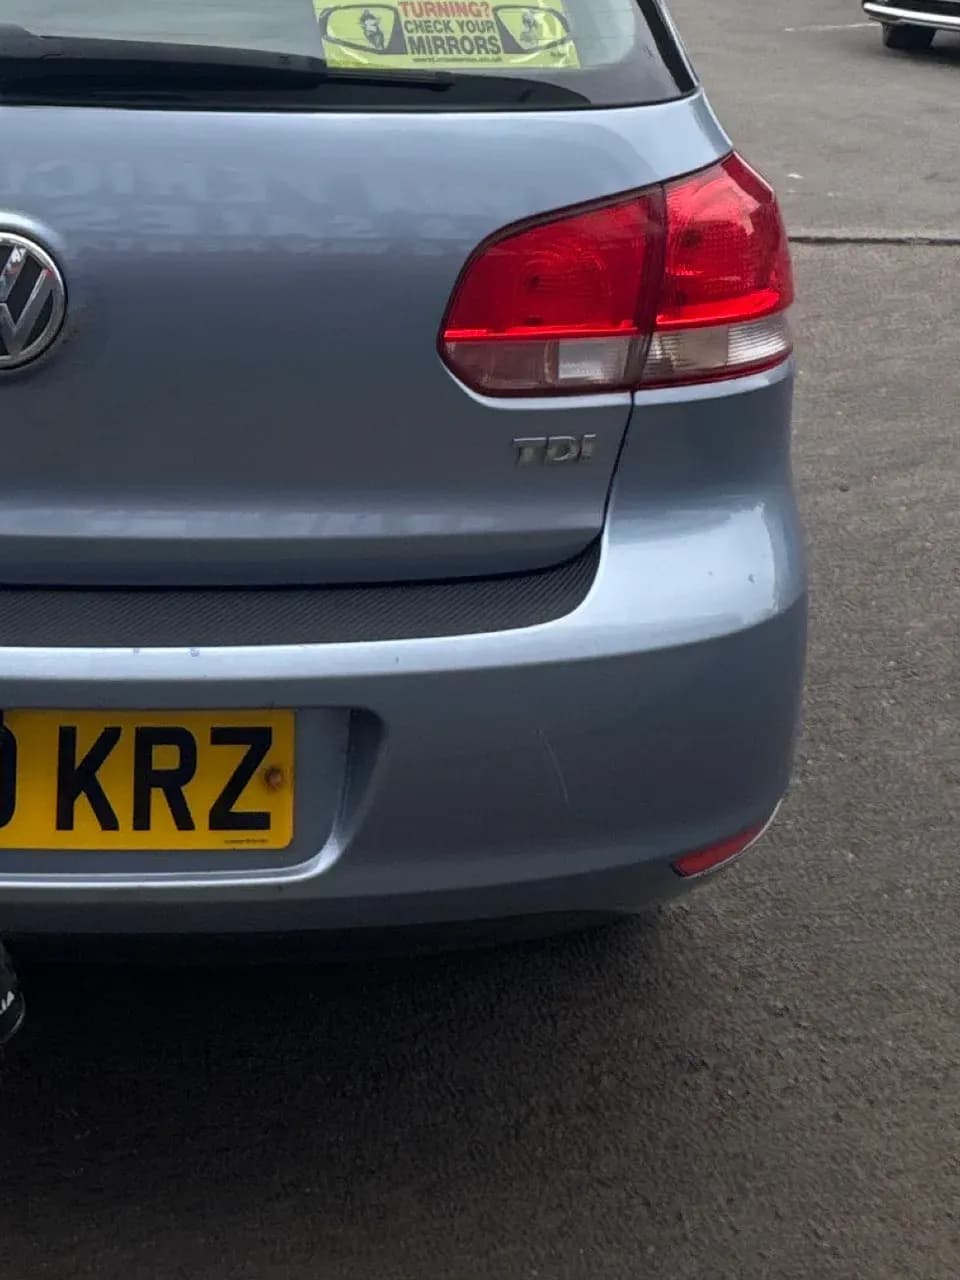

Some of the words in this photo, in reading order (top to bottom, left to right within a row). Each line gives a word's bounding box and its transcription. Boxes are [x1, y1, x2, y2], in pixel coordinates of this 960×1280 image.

[398, 0, 490, 19] TURNING?
[404, 19, 455, 35] CHECK
[457, 19, 495, 34] YOUR
[407, 35, 502, 55] MIRRORS
[513, 433, 596, 465] TDI
[56, 725, 273, 832] KRZ
